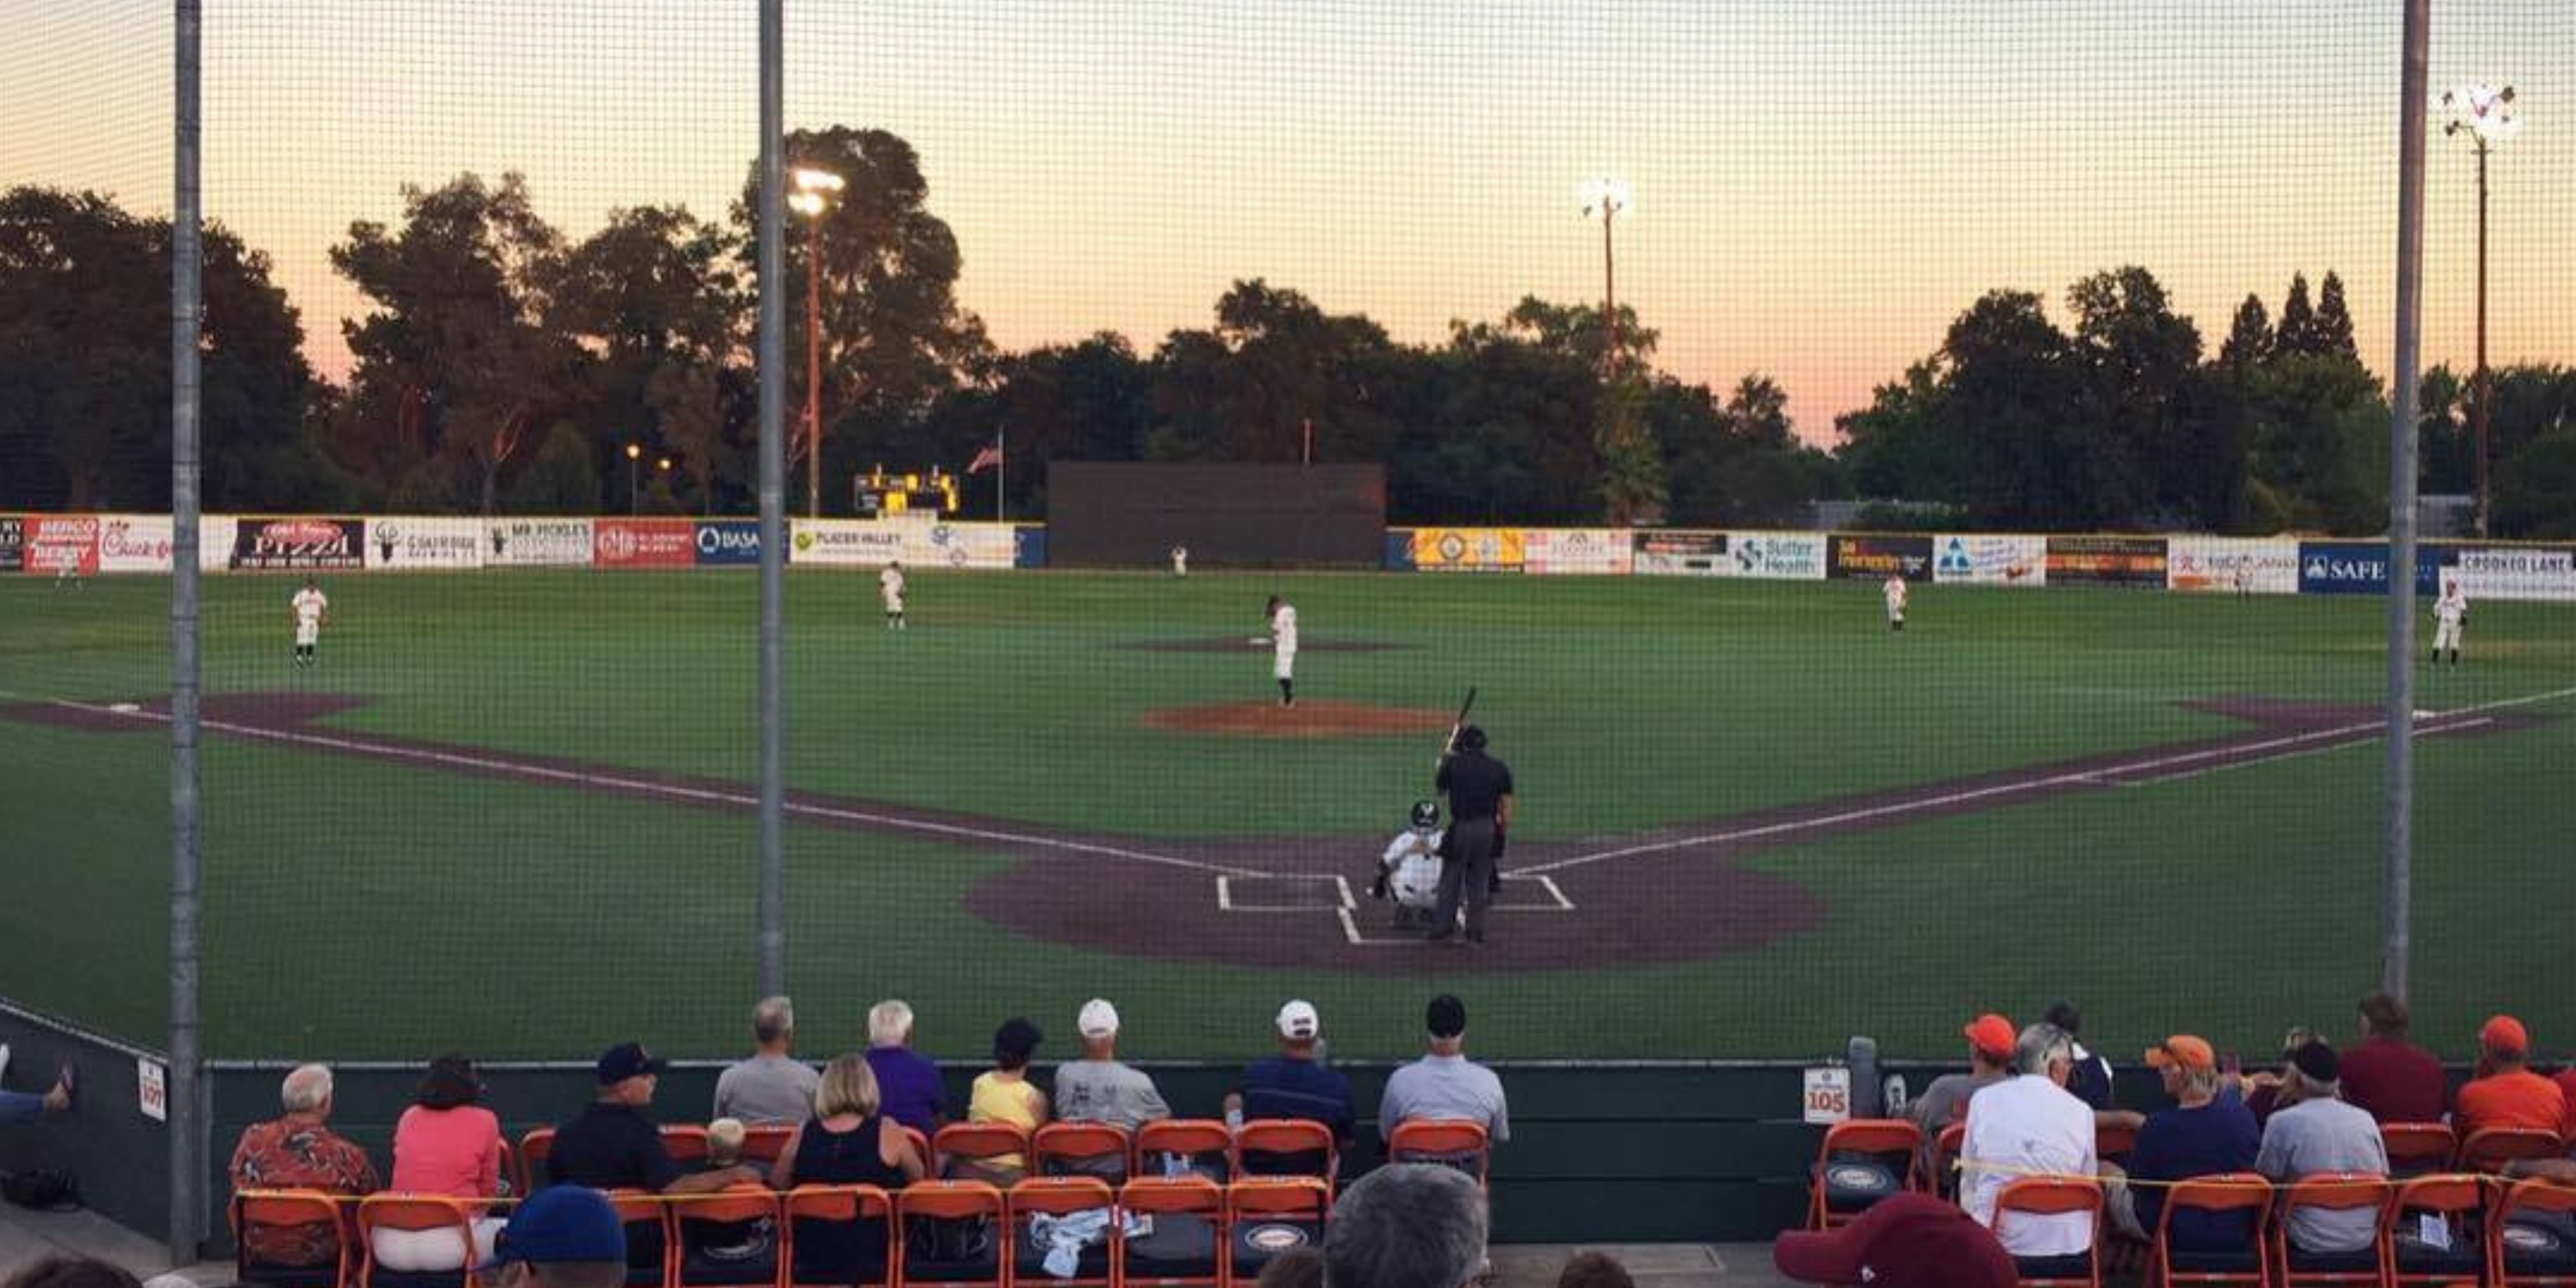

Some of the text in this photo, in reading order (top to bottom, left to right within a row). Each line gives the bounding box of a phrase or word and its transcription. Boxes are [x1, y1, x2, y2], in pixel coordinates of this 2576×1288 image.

[254, 534, 349, 555] PIZZA
[1766, 539, 1813, 556] Sutter
[1765, 556, 1815, 574] Health
[2329, 561, 2385, 580] SAFE
[1809, 1092, 1845, 1113] 105
